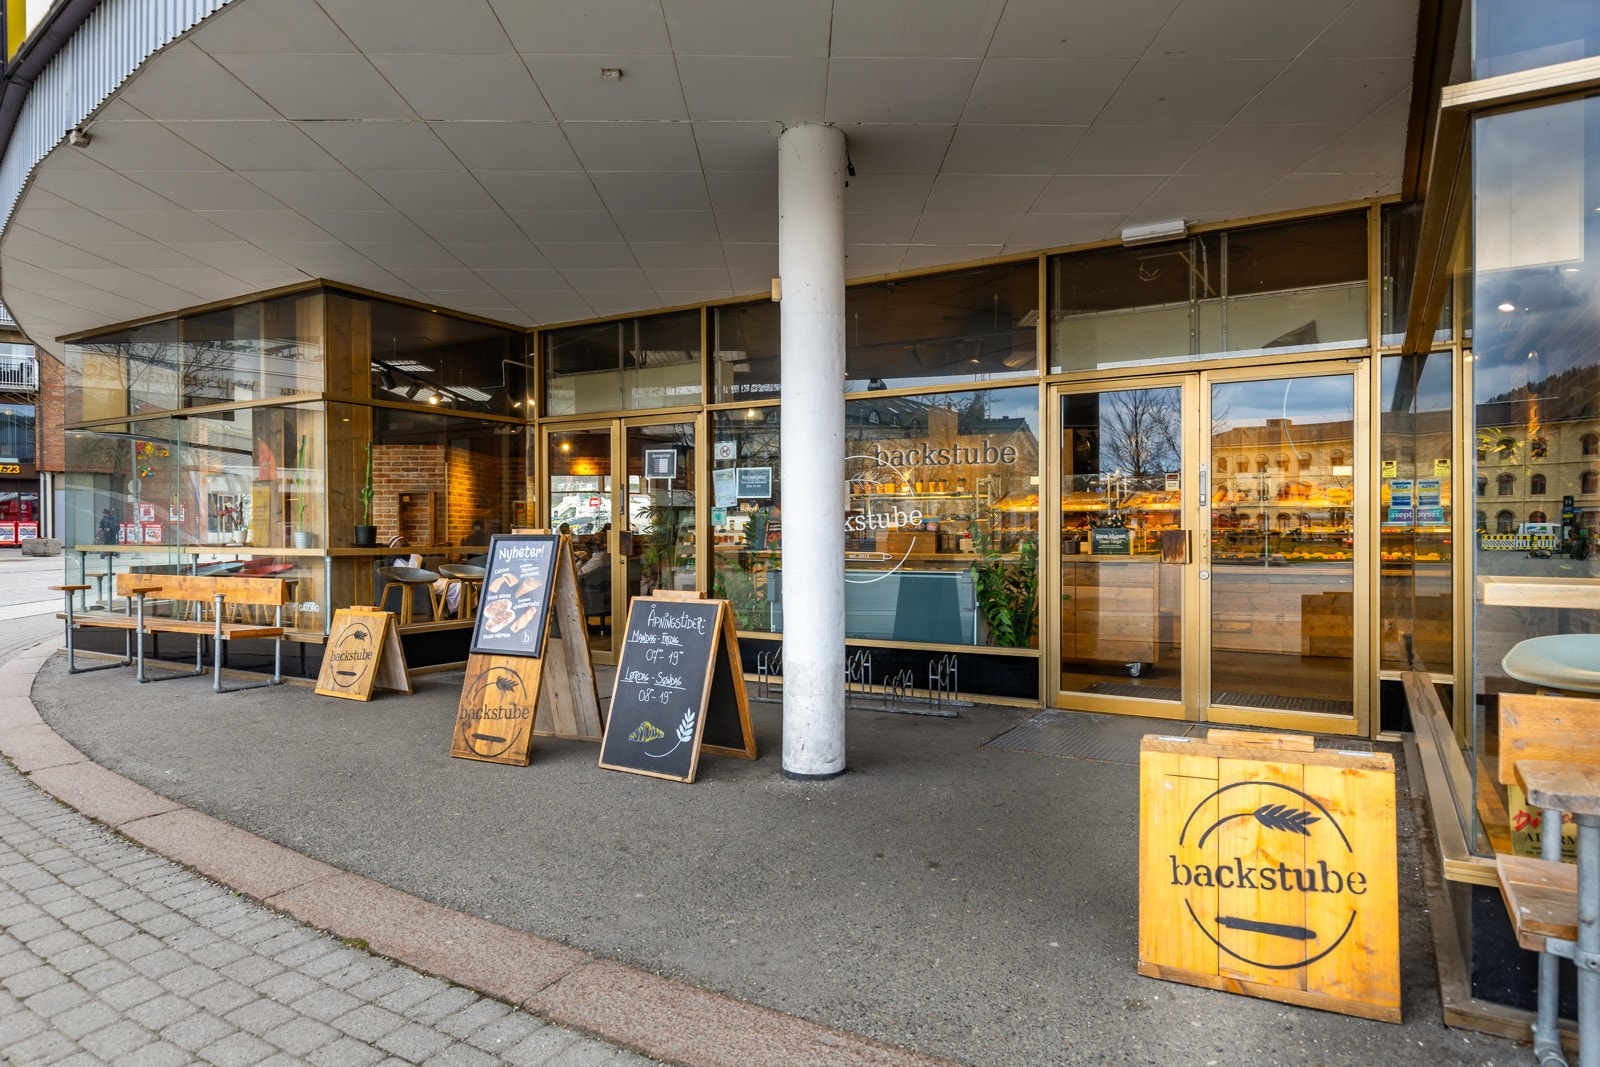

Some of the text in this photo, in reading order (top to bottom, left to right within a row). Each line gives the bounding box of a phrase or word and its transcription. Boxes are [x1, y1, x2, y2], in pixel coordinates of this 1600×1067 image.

[874, 439, 1017, 467] backstube
[844, 505, 923, 532] kstube
[499, 545, 545, 563] Nyheter!
[631, 630, 657, 642] MANDAG
[330, 648, 373, 662] backstube
[459, 702, 530, 720] backstube
[1169, 854, 1367, 895] backstube
